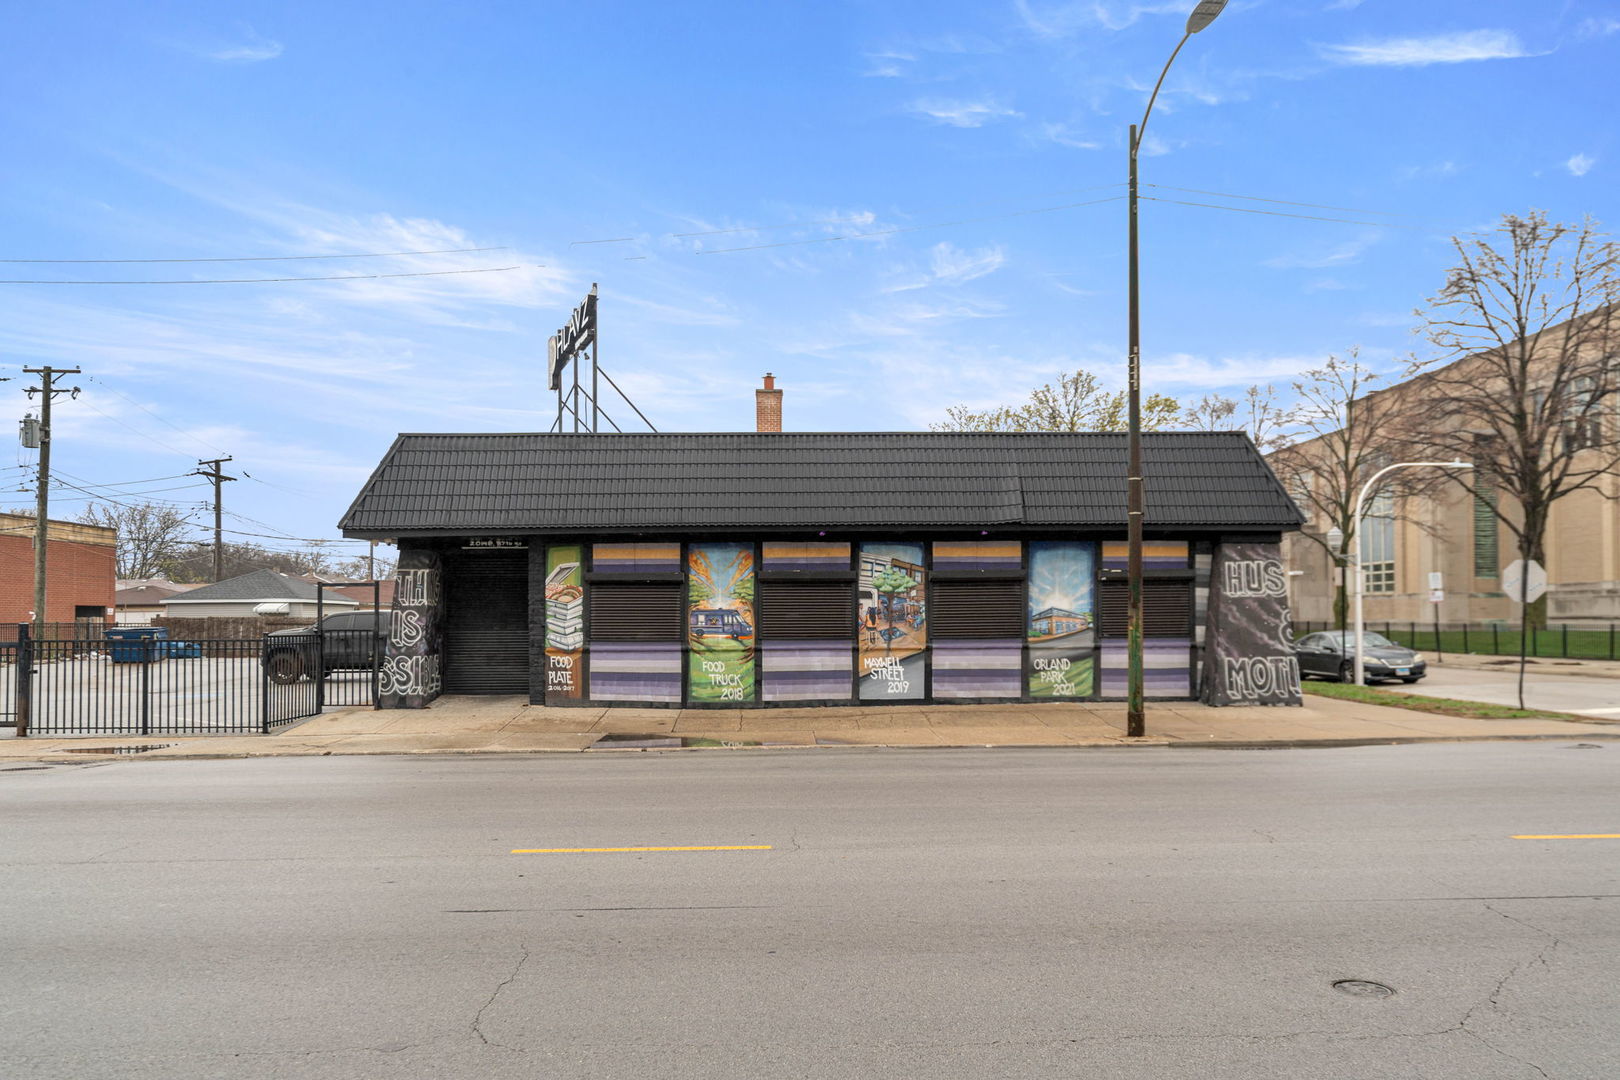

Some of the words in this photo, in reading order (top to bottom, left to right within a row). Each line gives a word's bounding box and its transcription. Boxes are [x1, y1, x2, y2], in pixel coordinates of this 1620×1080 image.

[391, 609, 421, 647] IS
[550, 656, 573, 669] FOOD
[702, 661, 725, 673] FOOD
[864, 657, 903, 670] MAXWELL
[1033, 658, 1071, 671] ORLAND
[548, 671, 574, 684] PLATE
[710, 673, 744, 688] TRUCK
[870, 669, 905, 681] STREET
[1040, 670, 1067, 684] PARK
[887, 681, 910, 694] 2019
[1052, 683, 1076, 696] 2021
[720, 688, 744, 701] 2018
